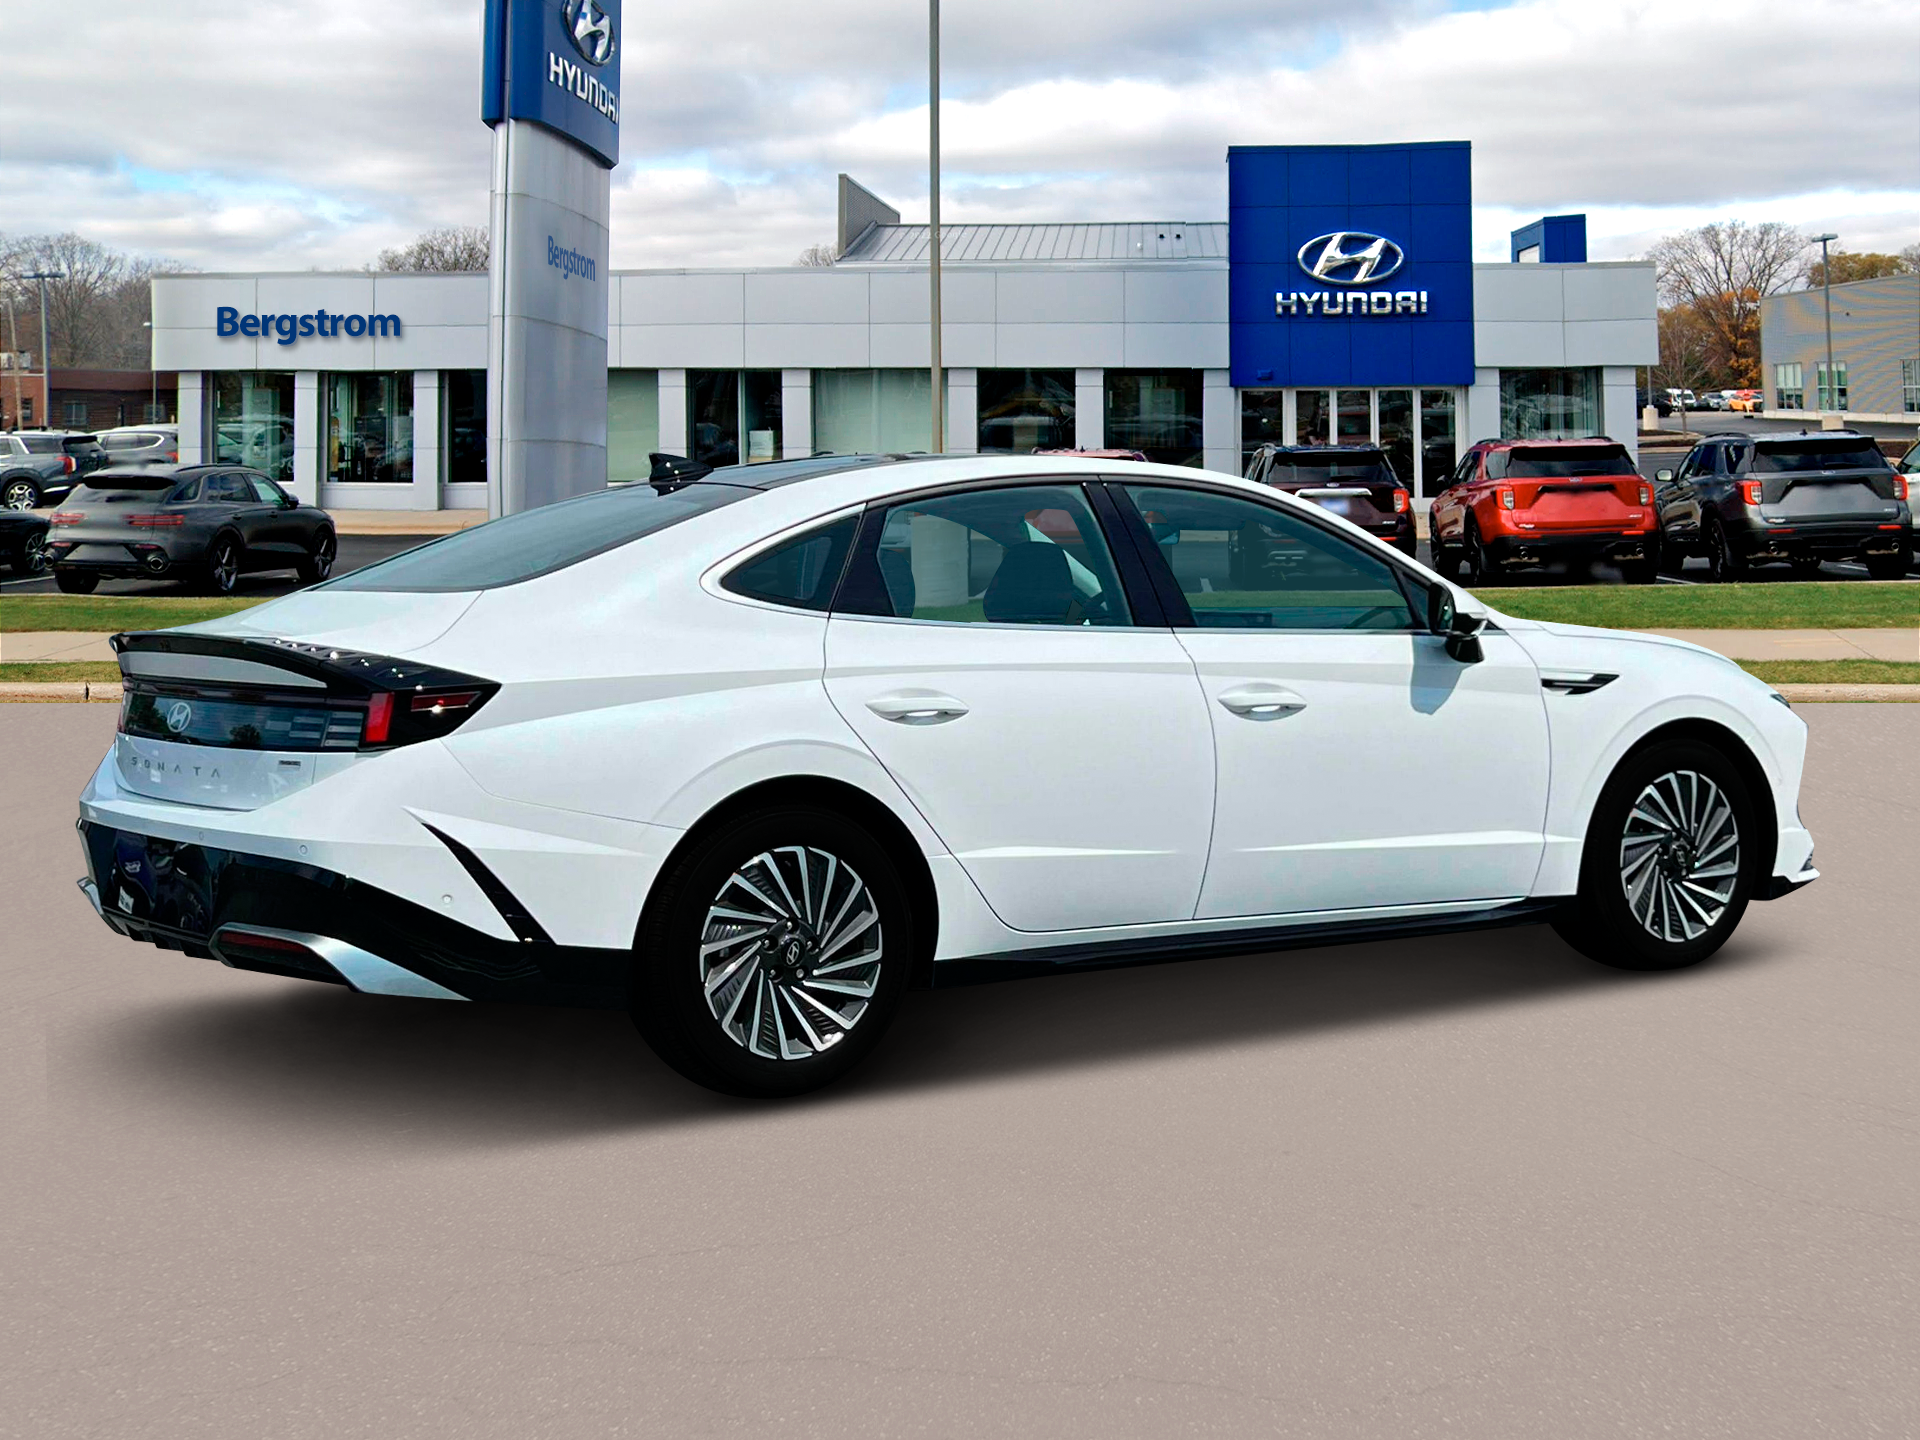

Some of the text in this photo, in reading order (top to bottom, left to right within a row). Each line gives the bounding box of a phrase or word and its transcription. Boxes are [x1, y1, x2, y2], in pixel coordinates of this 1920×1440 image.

[549, 51, 619, 124] HYUNDAI
[547, 234, 596, 283] Bergstrom
[1275, 290, 1428, 315] HYUNDAI
[216, 306, 401, 346] Bergstrom
[130, 756, 221, 779] SONATA
